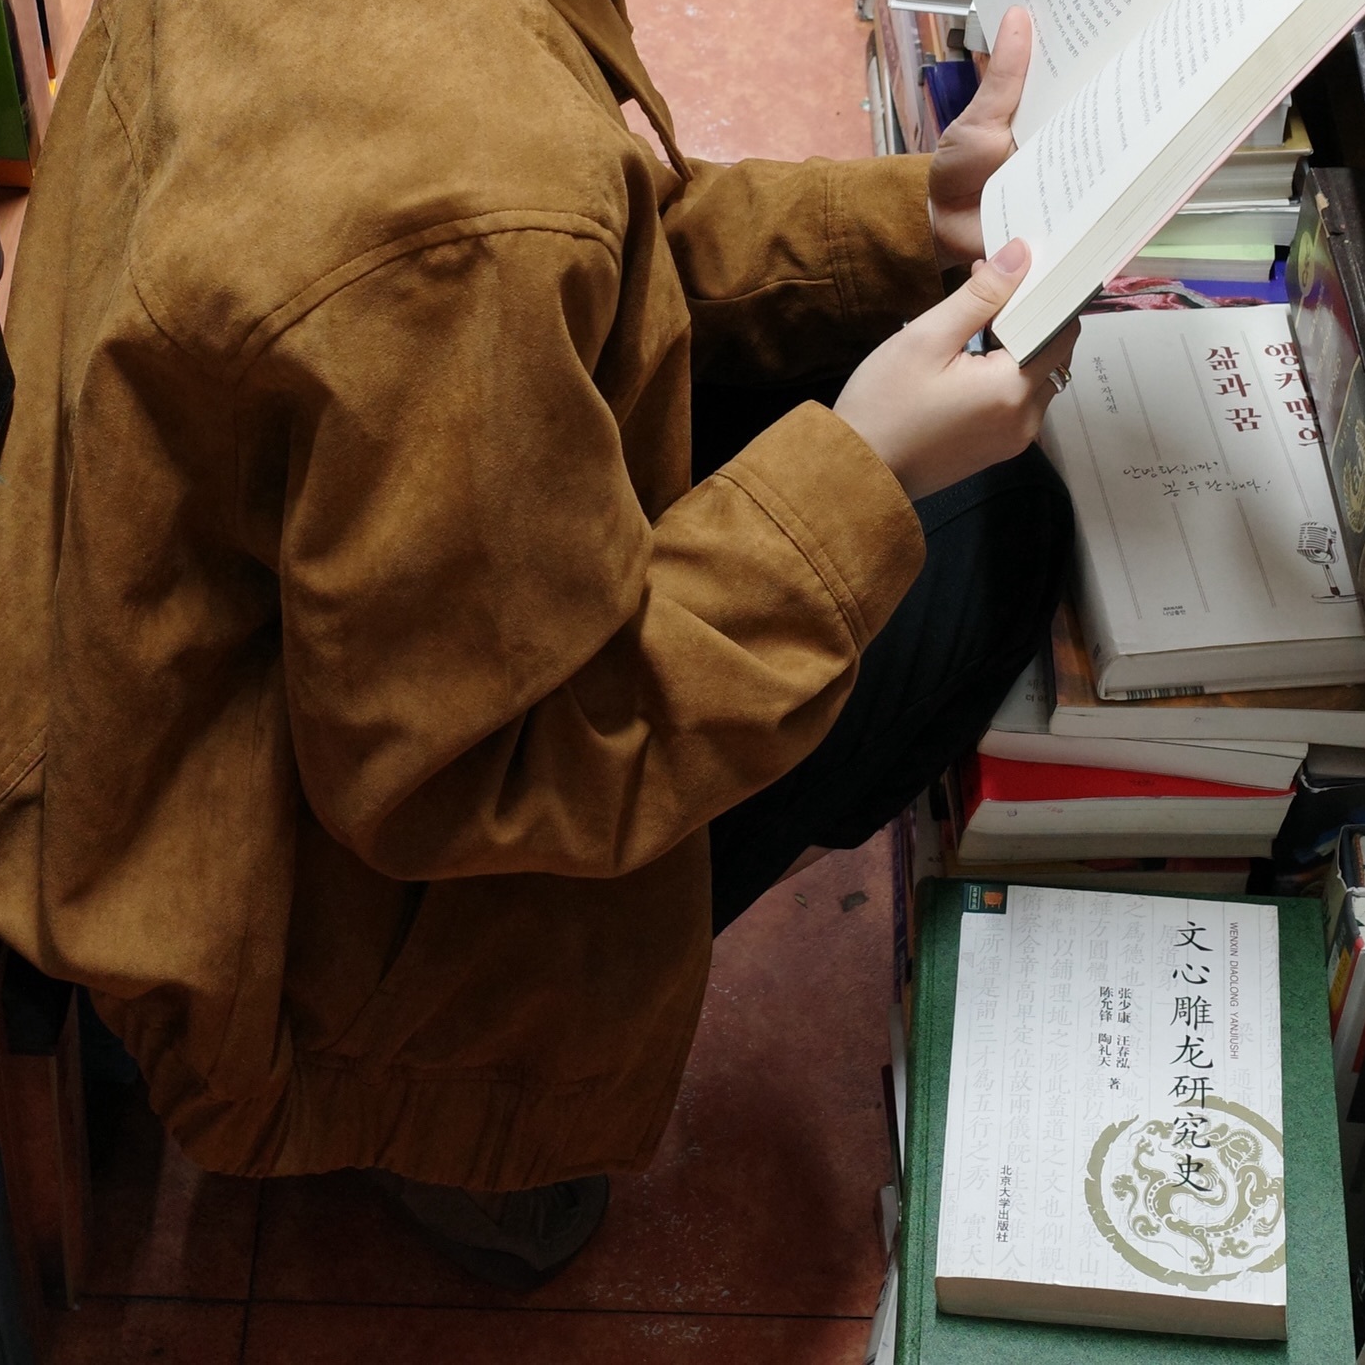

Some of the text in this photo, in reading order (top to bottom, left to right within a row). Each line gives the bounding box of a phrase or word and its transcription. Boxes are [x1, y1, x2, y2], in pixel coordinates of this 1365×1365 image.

[1099, 385, 1120, 415] 자서전
[1205, 345, 1262, 433] 삶과 꿈
[1117, 986, 1133, 1025] 张少康
[1228, 921, 1241, 1061] WENXIN DIAOLONG YANJIUSHI
[1097, 1032, 1114, 1068] 陶礼天
[1167, 920, 1215, 1193] 文心雕龙研究史
[994, 1163, 1013, 1244] 北京大学出版社
